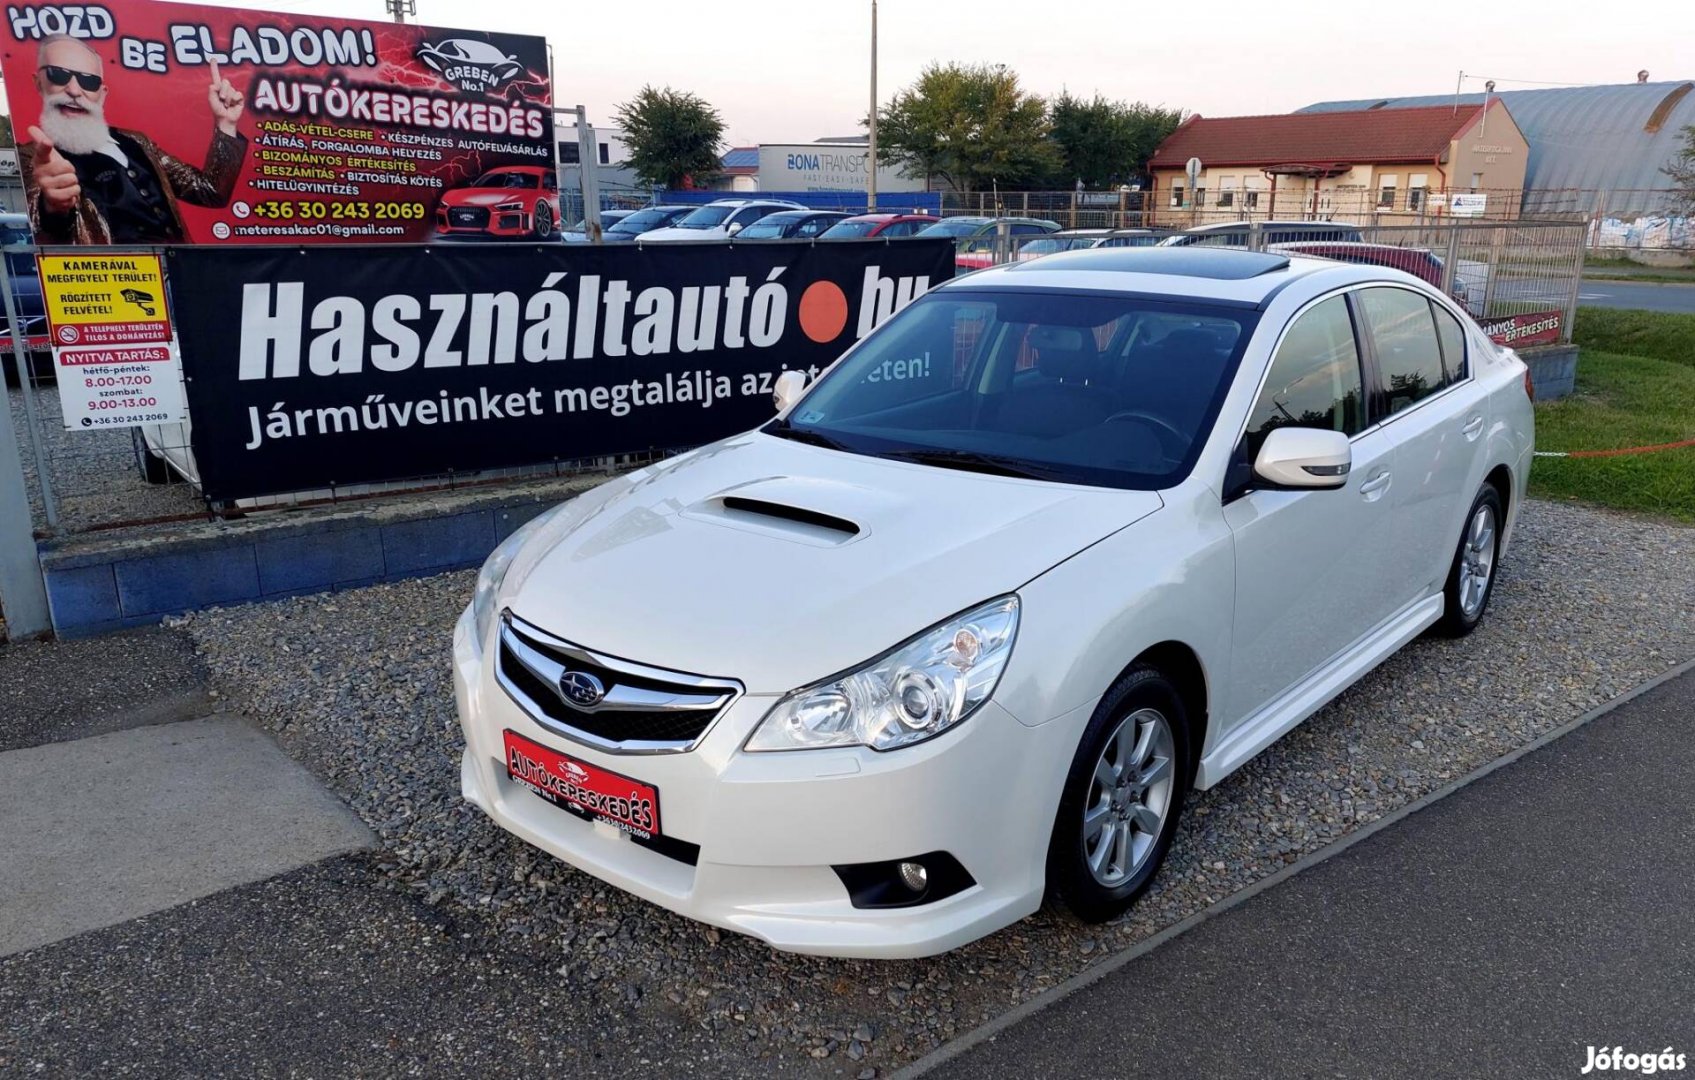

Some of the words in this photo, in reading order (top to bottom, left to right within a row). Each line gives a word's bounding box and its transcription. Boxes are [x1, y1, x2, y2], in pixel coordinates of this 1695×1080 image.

[8, 6, 114, 39] HOZD
[122, 38, 166, 72] BE
[171, 25, 376, 65] ELADOM!
[445, 66, 499, 87] GREBEN
[462, 80, 484, 92] No.1
[255, 78, 543, 138] AUTÓKERESKEDÉS
[264, 121, 373, 140] ADÁS-VÉTEL-CSERE
[262, 133, 308, 150] ÁTÍRÁS,
[312, 140, 390, 156] FORGALOMBA
[392, 147, 442, 161] HELYEZÉS
[388, 132, 453, 148] KÉSZPÉNZES
[458, 139, 548, 157] AUTÓFELVÁSÁRLÁS
[262, 150, 342, 166] BIZOMÁNYOS
[347, 156, 416, 172] ÉRTÉKESÍTÉS
[263, 165, 335, 180] BESZÁMÍTÁS
[347, 171, 407, 186] BIZTOSÍTÁS
[410, 175, 443, 188] KÖTÉS
[257, 179, 359, 195] HITELÜGYINTÉZÉS
[254, 202, 294, 219] +36
[299, 202, 326, 219] 30
[331, 202, 370, 219] 243
[375, 202, 425, 219] 2069
[63, 259, 138, 271] KAMERÁVAL
[47, 274, 108, 283] MEGFIGYELT
[112, 272, 157, 283] TERÜLET!
[60, 291, 112, 303] RÖGZÍTETT
[64, 304, 112, 315] FELVÉTEL!
[90, 325, 126, 333] TELEPHELY
[239, 266, 788, 380] Használtautó
[117, 331, 165, 340] DOHÁNYZÁS!
[65, 352, 113, 363] NYITVA
[115, 348, 164, 361] TARTÁS:
[83, 364, 150, 375] hétfő-péntek:
[85, 375, 152, 388] 8.00-17.00
[99, 388, 143, 397] szombat:
[88, 397, 157, 410] 9.00-13.00
[245, 386, 543, 451] Járműveinket
[554, 370, 731, 417] megtalálja
[741, 370, 773, 398] az
[94, 417, 110, 425] +36
[113, 416, 125, 424] 30
[126, 415, 144, 423] 243
[146, 413, 168, 421] 2069
[510, 745, 654, 831] AUTÓKERESKEDÉS
